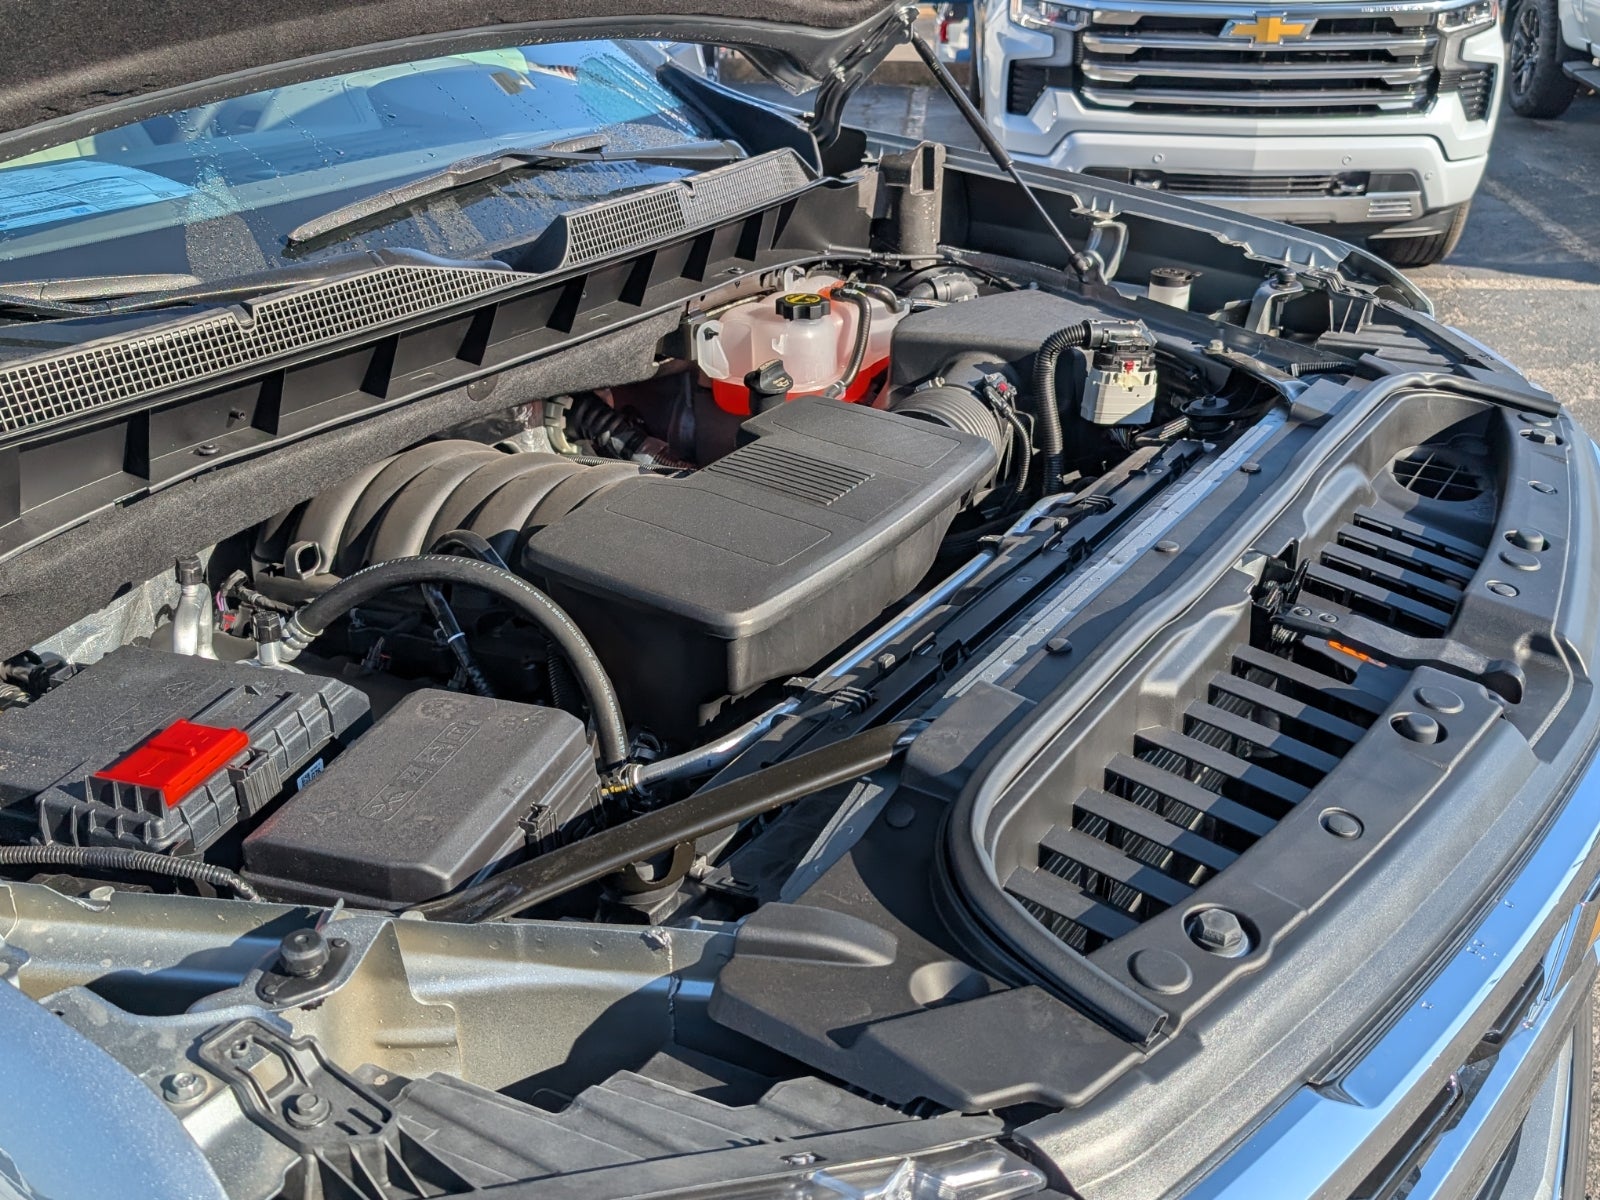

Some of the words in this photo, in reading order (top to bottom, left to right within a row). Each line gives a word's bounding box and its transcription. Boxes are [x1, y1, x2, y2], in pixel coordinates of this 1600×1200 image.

[551, 607, 567, 623] HOSE
[565, 622, 586, 647] SUCTION
[584, 647, 593, 658] A/C
